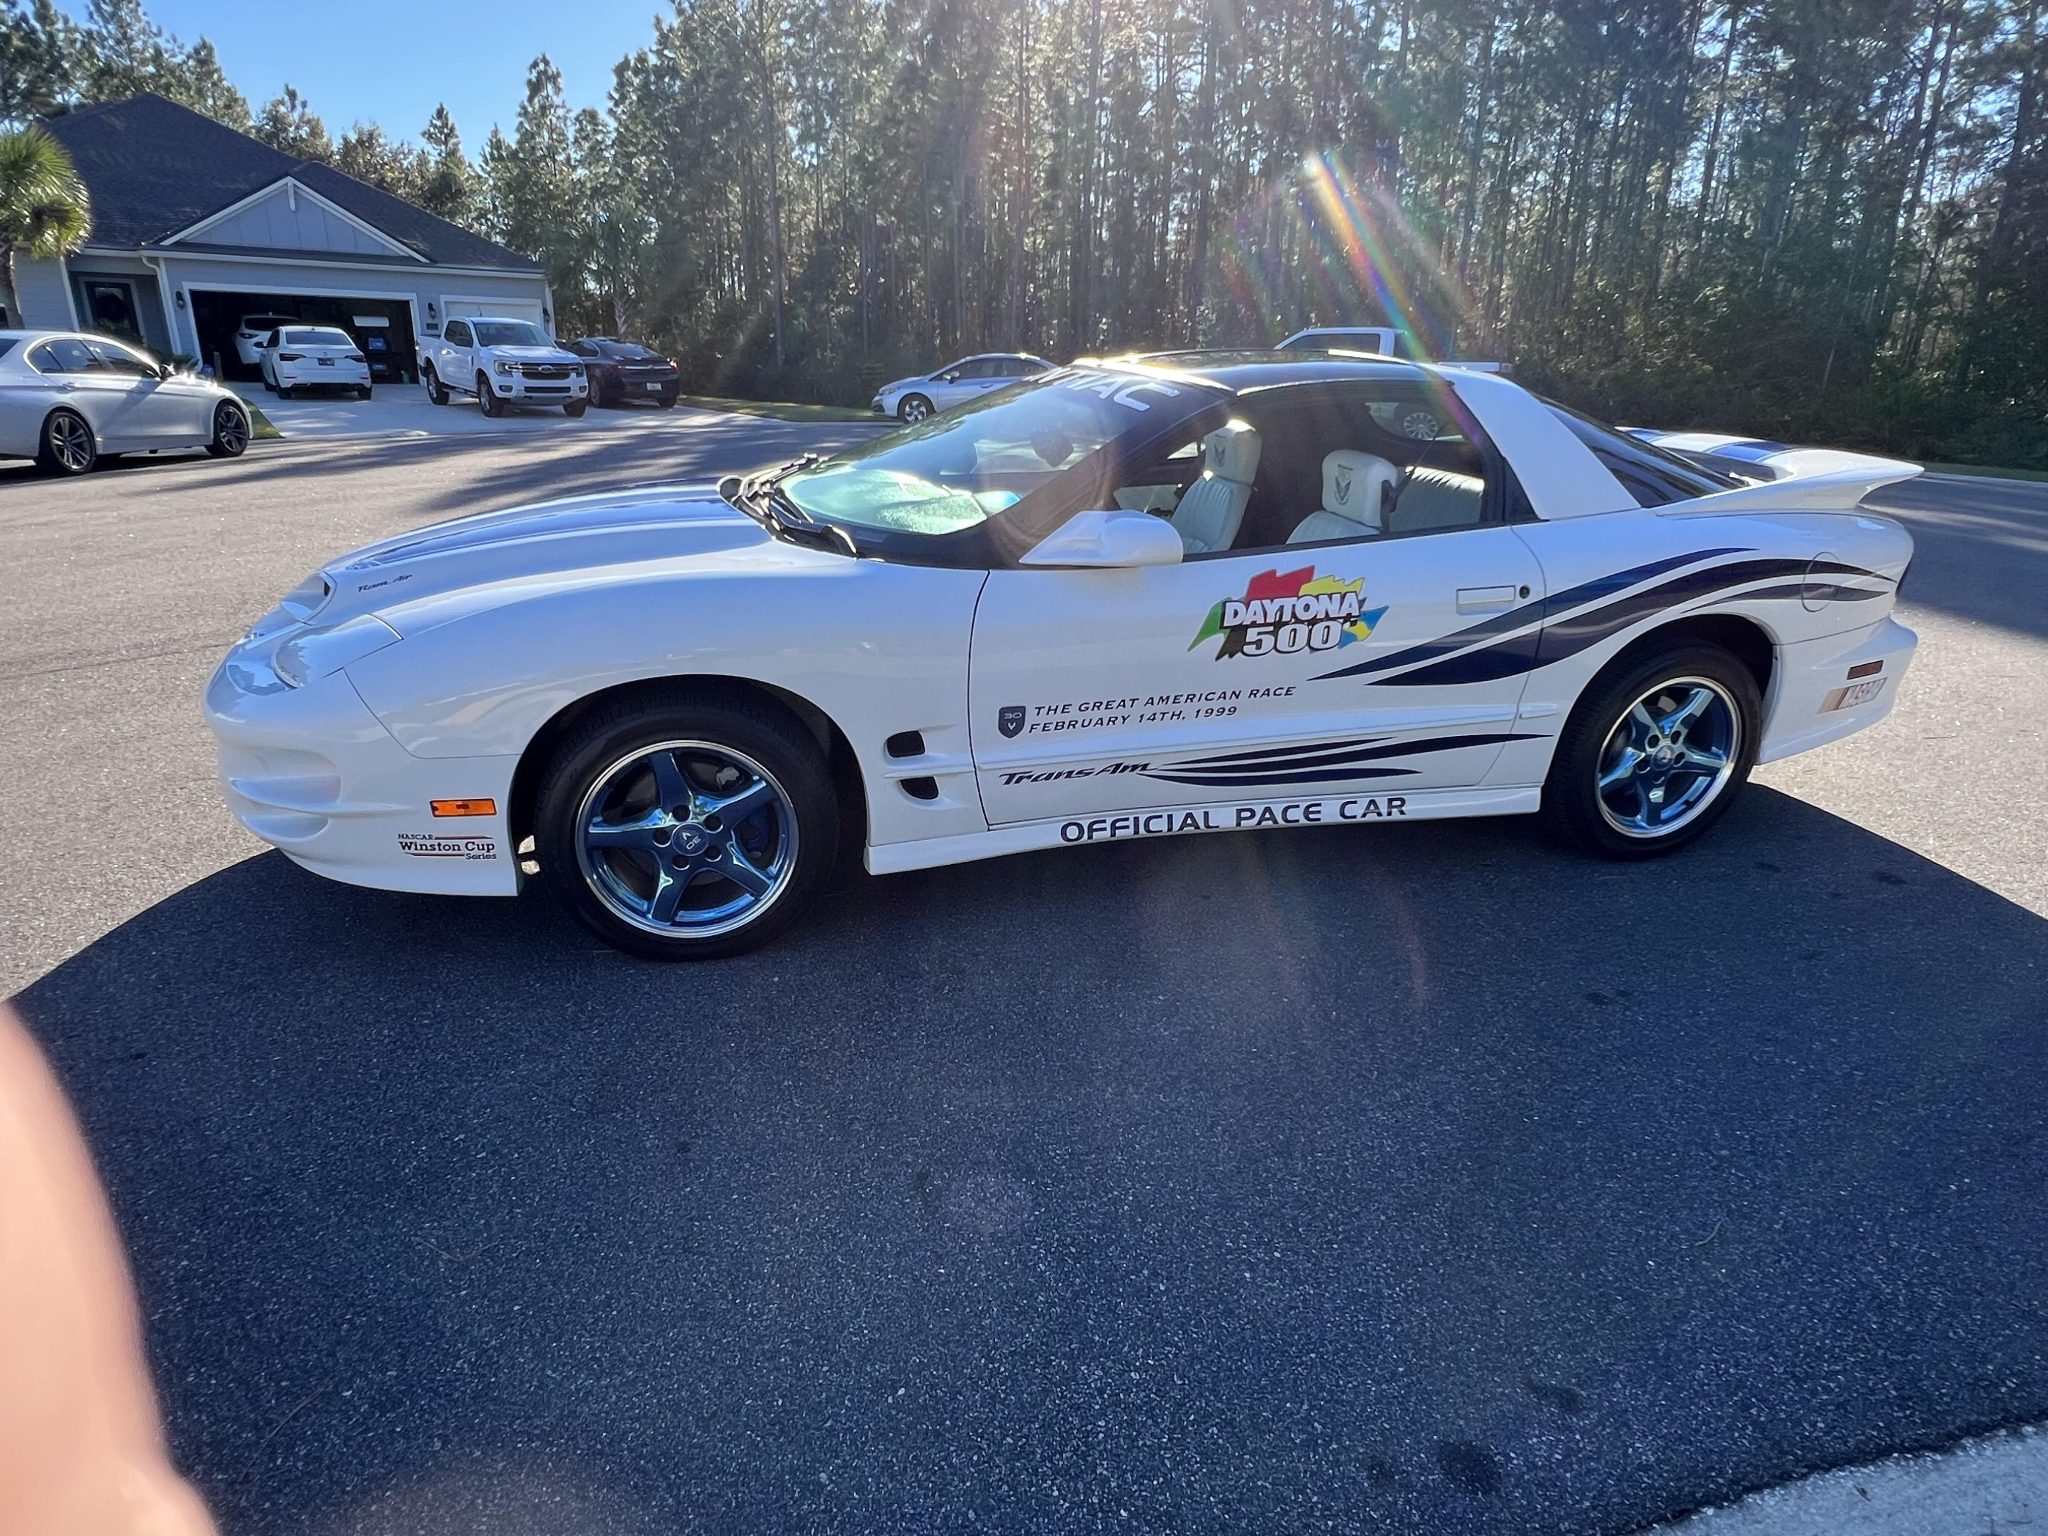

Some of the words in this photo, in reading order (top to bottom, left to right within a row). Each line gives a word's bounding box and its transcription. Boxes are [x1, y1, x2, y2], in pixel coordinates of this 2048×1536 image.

[1222, 592, 1360, 628] DAYTONA
[1242, 621, 1343, 656] 500
[1034, 704, 1072, 716] THE
[1078, 698, 1140, 712] GREAT
[1143, 690, 1242, 707] AMERICAN
[1248, 686, 1297, 700] RACE
[1028, 714, 1131, 734] FEBRUARY
[1194, 706, 1238, 719] 1999
[999, 768, 1096, 785] Trans
[1094, 762, 1158, 777] Am
[1060, 811, 1220, 843] OFFICIAL
[1235, 803, 1322, 827] PACE
[1339, 797, 1406, 818] CAR
[399, 841, 462, 852] Winston
[465, 841, 496, 853] Cup
